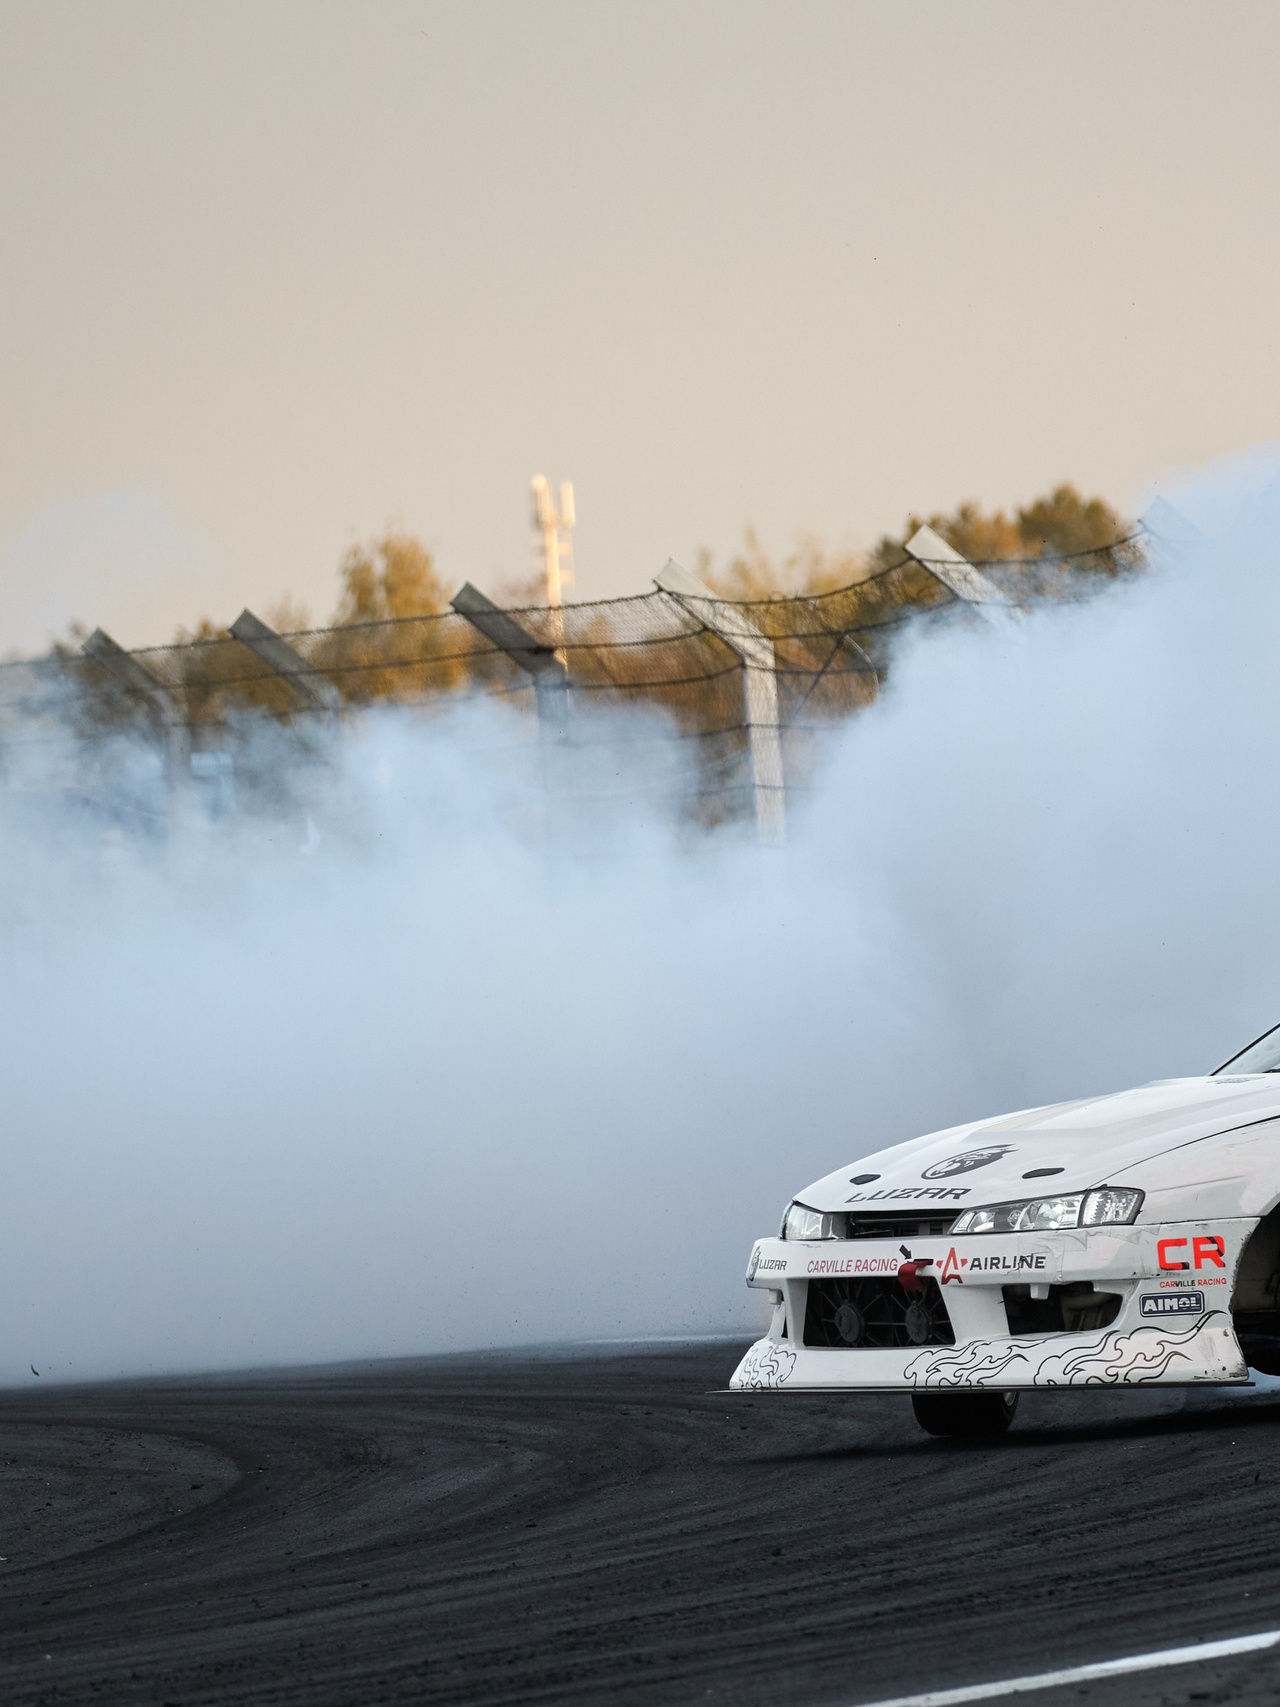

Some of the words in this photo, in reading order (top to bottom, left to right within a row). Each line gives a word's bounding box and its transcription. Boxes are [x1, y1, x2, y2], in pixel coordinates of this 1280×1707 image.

[844, 1187, 972, 1204] LUZAR
[1157, 1235, 1226, 1271] CR
[758, 1258, 788, 1271] LUZAR
[807, 1259, 852, 1274] CARVILLE
[854, 1257, 899, 1273] RACING
[969, 1255, 1047, 1271] AIRLINE
[1160, 1280, 1196, 1289] CARVILLE
[1197, 1278, 1227, 1286] RACING
[1143, 1296, 1201, 1312] AIMOL
